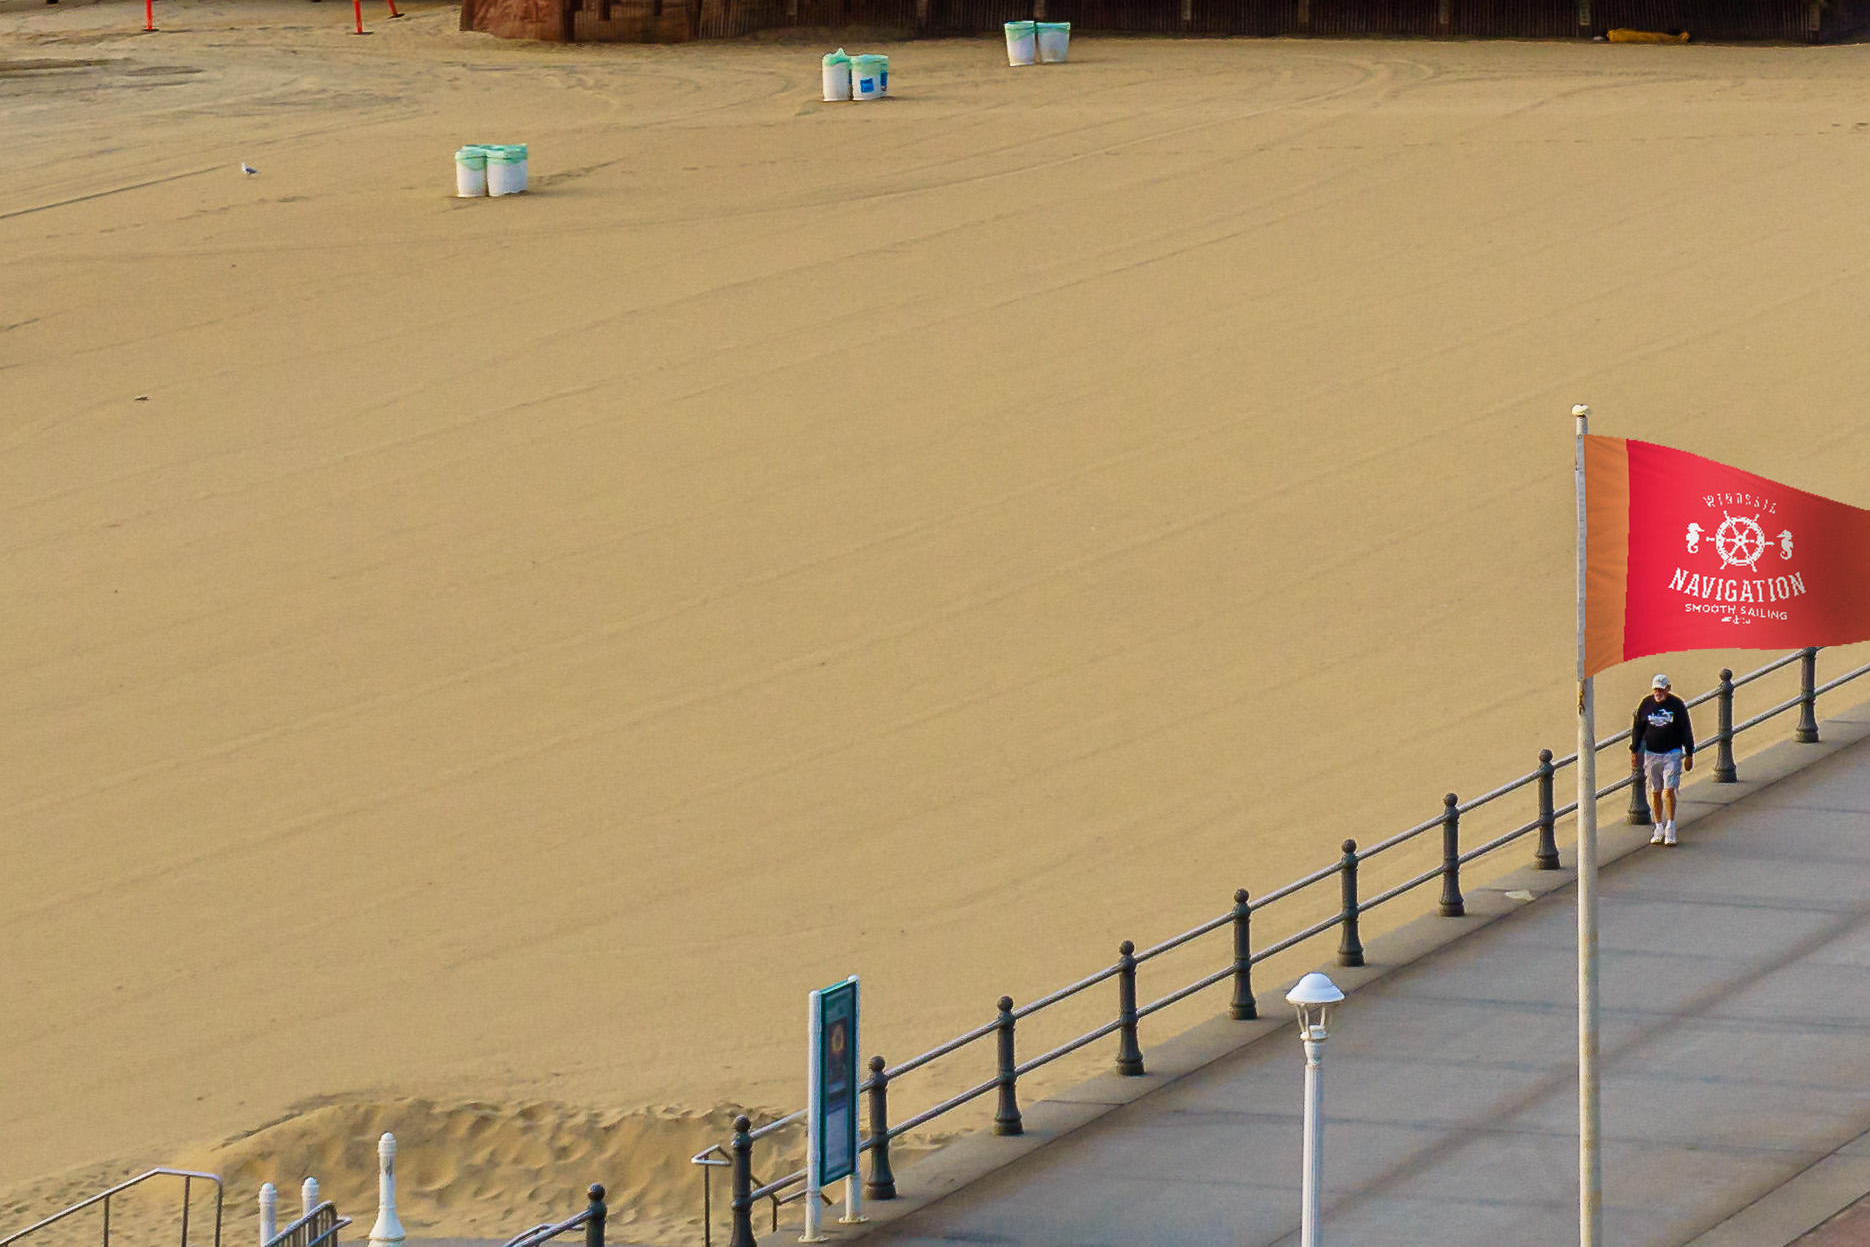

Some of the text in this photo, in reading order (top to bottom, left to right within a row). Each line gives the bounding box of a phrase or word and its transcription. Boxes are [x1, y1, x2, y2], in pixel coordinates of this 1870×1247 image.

[1668, 566, 1807, 603] NAVIGATION
[1684, 602, 1737, 615] SMOOTH
[1740, 605, 1789, 621] SAILING
